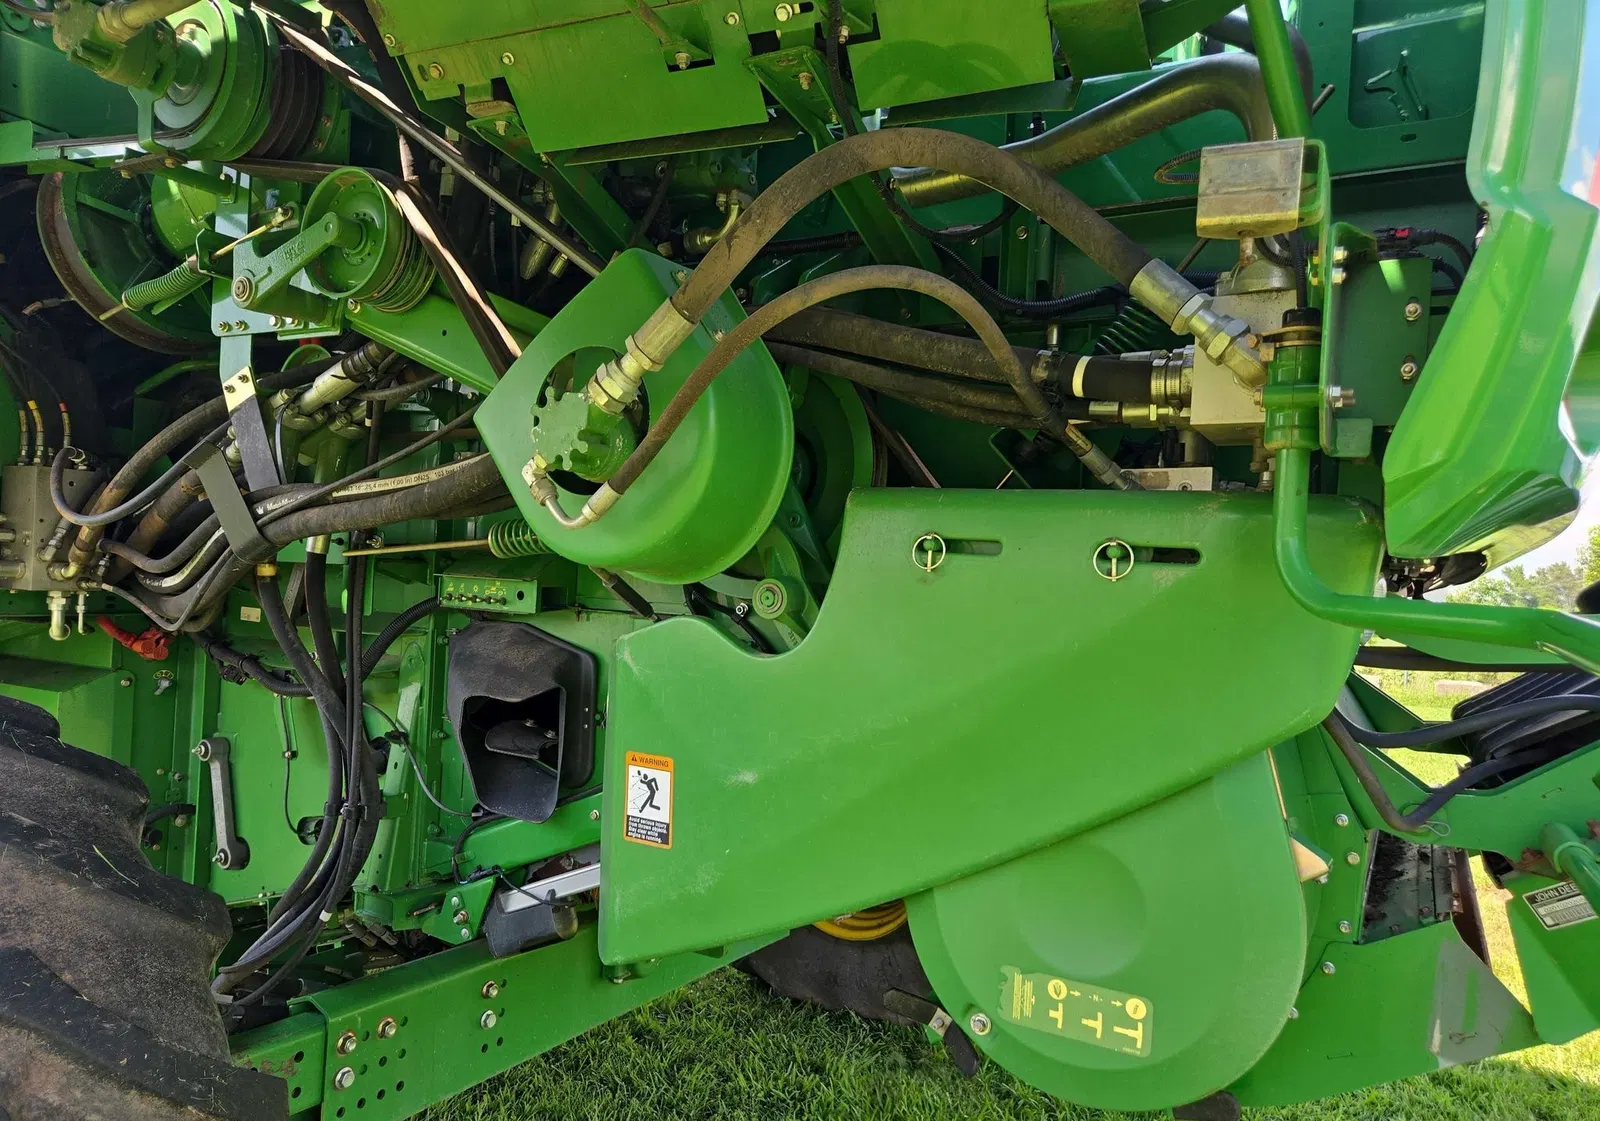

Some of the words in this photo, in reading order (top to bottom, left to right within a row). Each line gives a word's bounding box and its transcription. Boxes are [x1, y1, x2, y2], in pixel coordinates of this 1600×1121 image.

[639, 755, 669, 768] WARNING
[1534, 889, 1559, 902] JOHN
[1558, 883, 1578, 895] DEE
